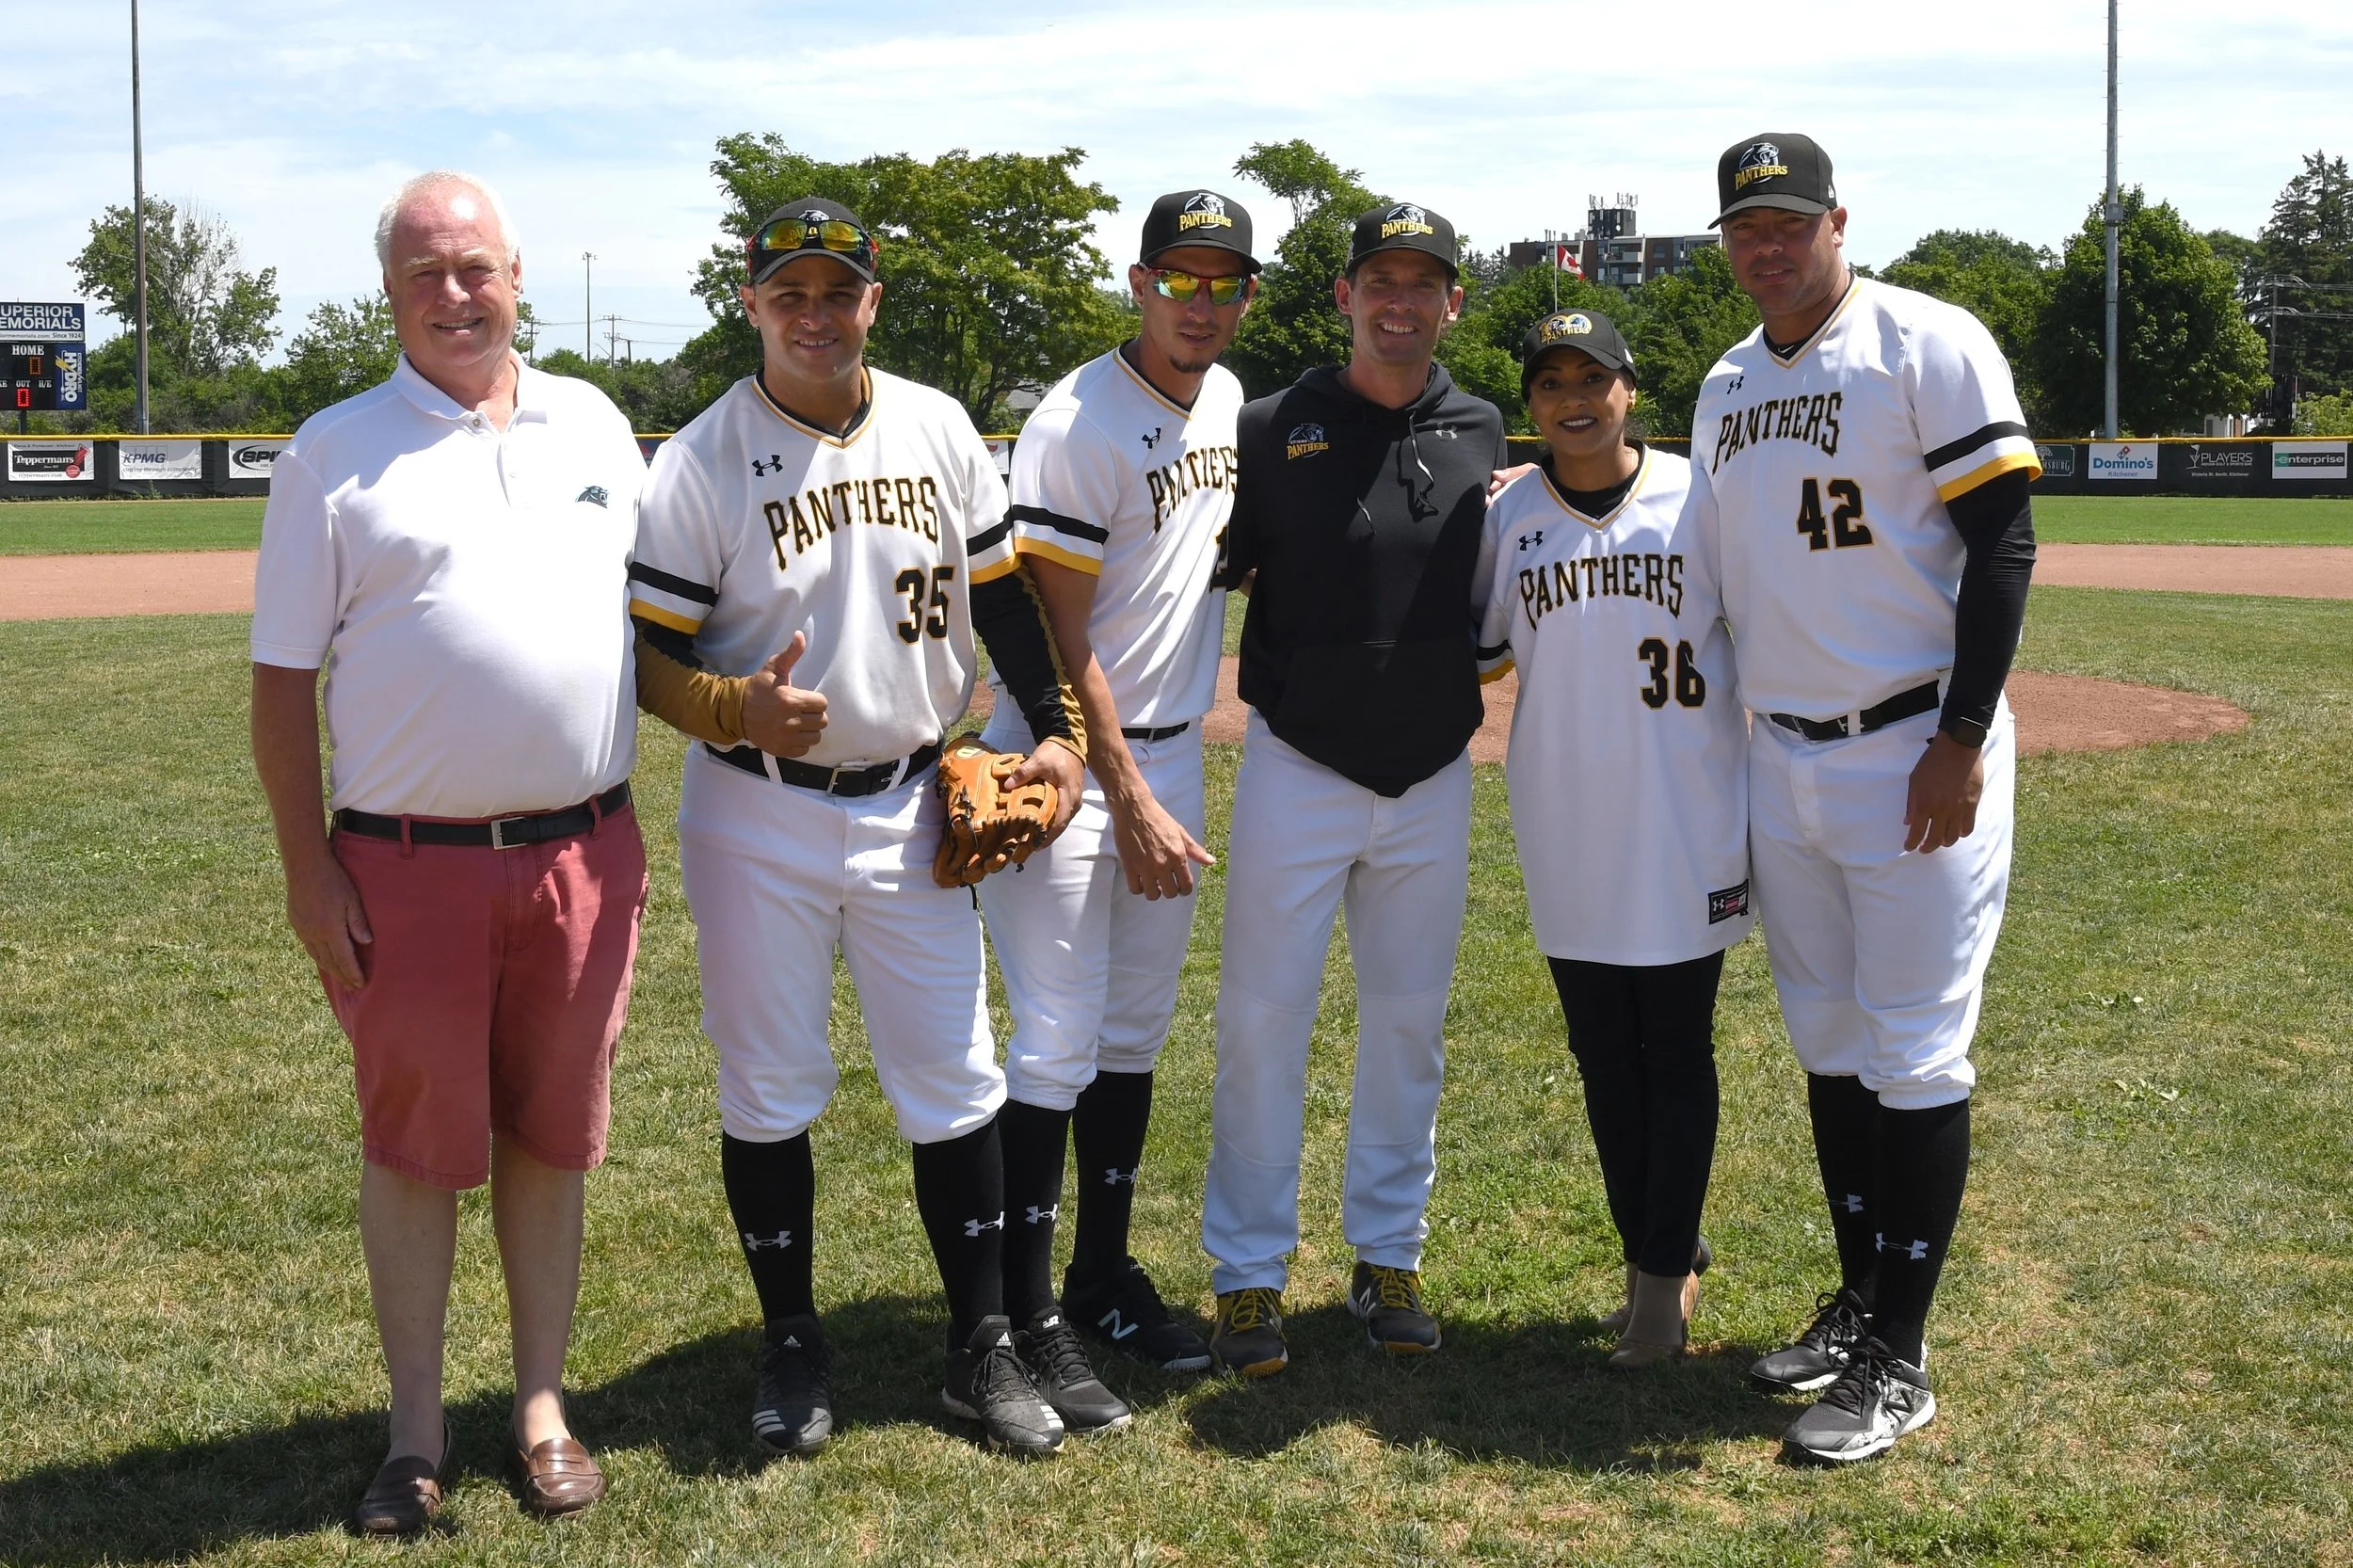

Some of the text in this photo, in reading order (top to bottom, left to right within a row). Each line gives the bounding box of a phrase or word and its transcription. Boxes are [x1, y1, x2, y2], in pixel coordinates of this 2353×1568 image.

[1736, 166, 1787, 190] PANTHERS
[1178, 213, 1232, 232] PANTHERS
[1381, 222, 1433, 239] PANTHERS
[0, 305, 73, 318] UPERIOR
[0, 317, 82, 329] EMORIALS
[11, 344, 44, 356] HOME
[15, 379, 31, 388] OUT
[64, 352, 77, 403] HYDRO
[17, 388, 29, 407] 0
[1712, 392, 1843, 476] PANTHERS
[123, 453, 167, 464] KPMG
[1287, 442, 1329, 459] PANTHERS
[2201, 452, 2253, 463] PLAYERS
[2276, 454, 2345, 465] enterprise
[2092, 456, 2154, 470] Domino's
[763, 475, 938, 571] PANTHERS
[1796, 476, 1875, 552] 42
[1518, 553, 1684, 632] PANTHERS
[894, 566, 957, 646] 35
[1637, 636, 1706, 711] 36
